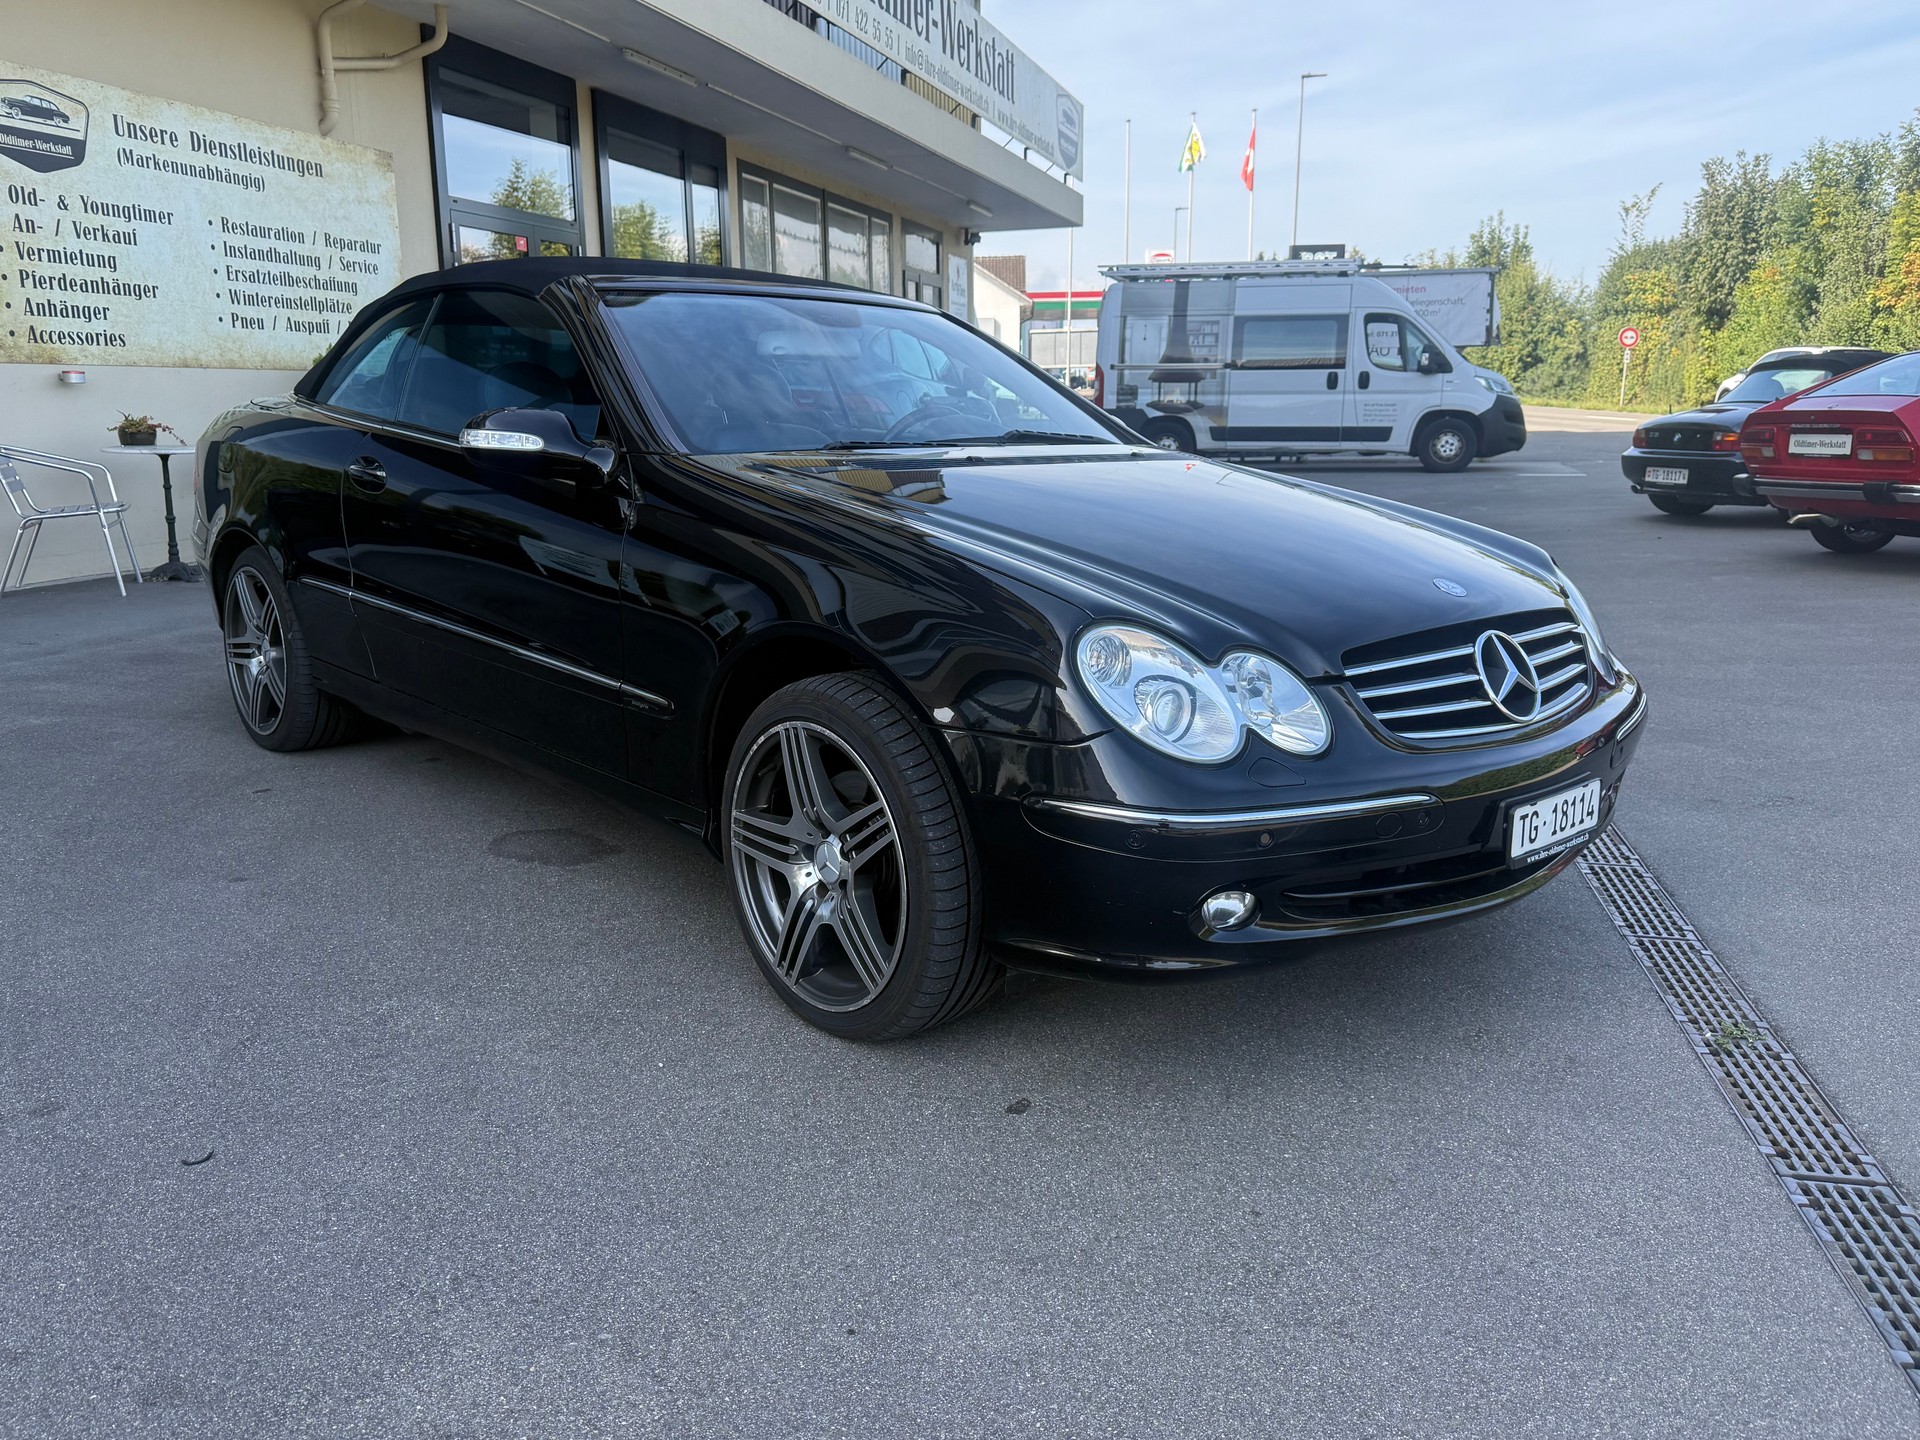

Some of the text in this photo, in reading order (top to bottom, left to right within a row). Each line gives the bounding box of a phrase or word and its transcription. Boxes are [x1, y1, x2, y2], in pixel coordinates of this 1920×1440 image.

[855, 6, 868, 34] 422
[873, 18, 881, 43] 55
[885, 26, 893, 51] 55
[0, 133, 73, 156] Oldtimer-Werkstatt
[112, 114, 324, 178] Unsere Dienstleistungen
[117, 147, 265, 192] (Markenunabhängig)
[8, 184, 174, 225] Old- & Youngtimer
[12, 213, 43, 234] An-
[72, 220, 138, 246] Verkauf
[221, 216, 305, 244] Restauration
[324, 232, 382, 255] Reparatur
[14, 241, 117, 272] Vermietung
[223, 240, 321, 271] Instandhaltung
[339, 256, 379, 276] Service
[18, 269, 159, 300] Pferdeanhänger
[226, 265, 358, 296] Ersatzteilbeschaffung
[24, 297, 110, 323] Anhänger
[228, 288, 353, 314] Wintereinstellplätze
[27, 325, 127, 347] Accessories
[231, 312, 265, 331] Pneu
[286, 316, 331, 336] Auspuff
[1793, 439, 1847, 449] Oldtimer-Werkstatt
